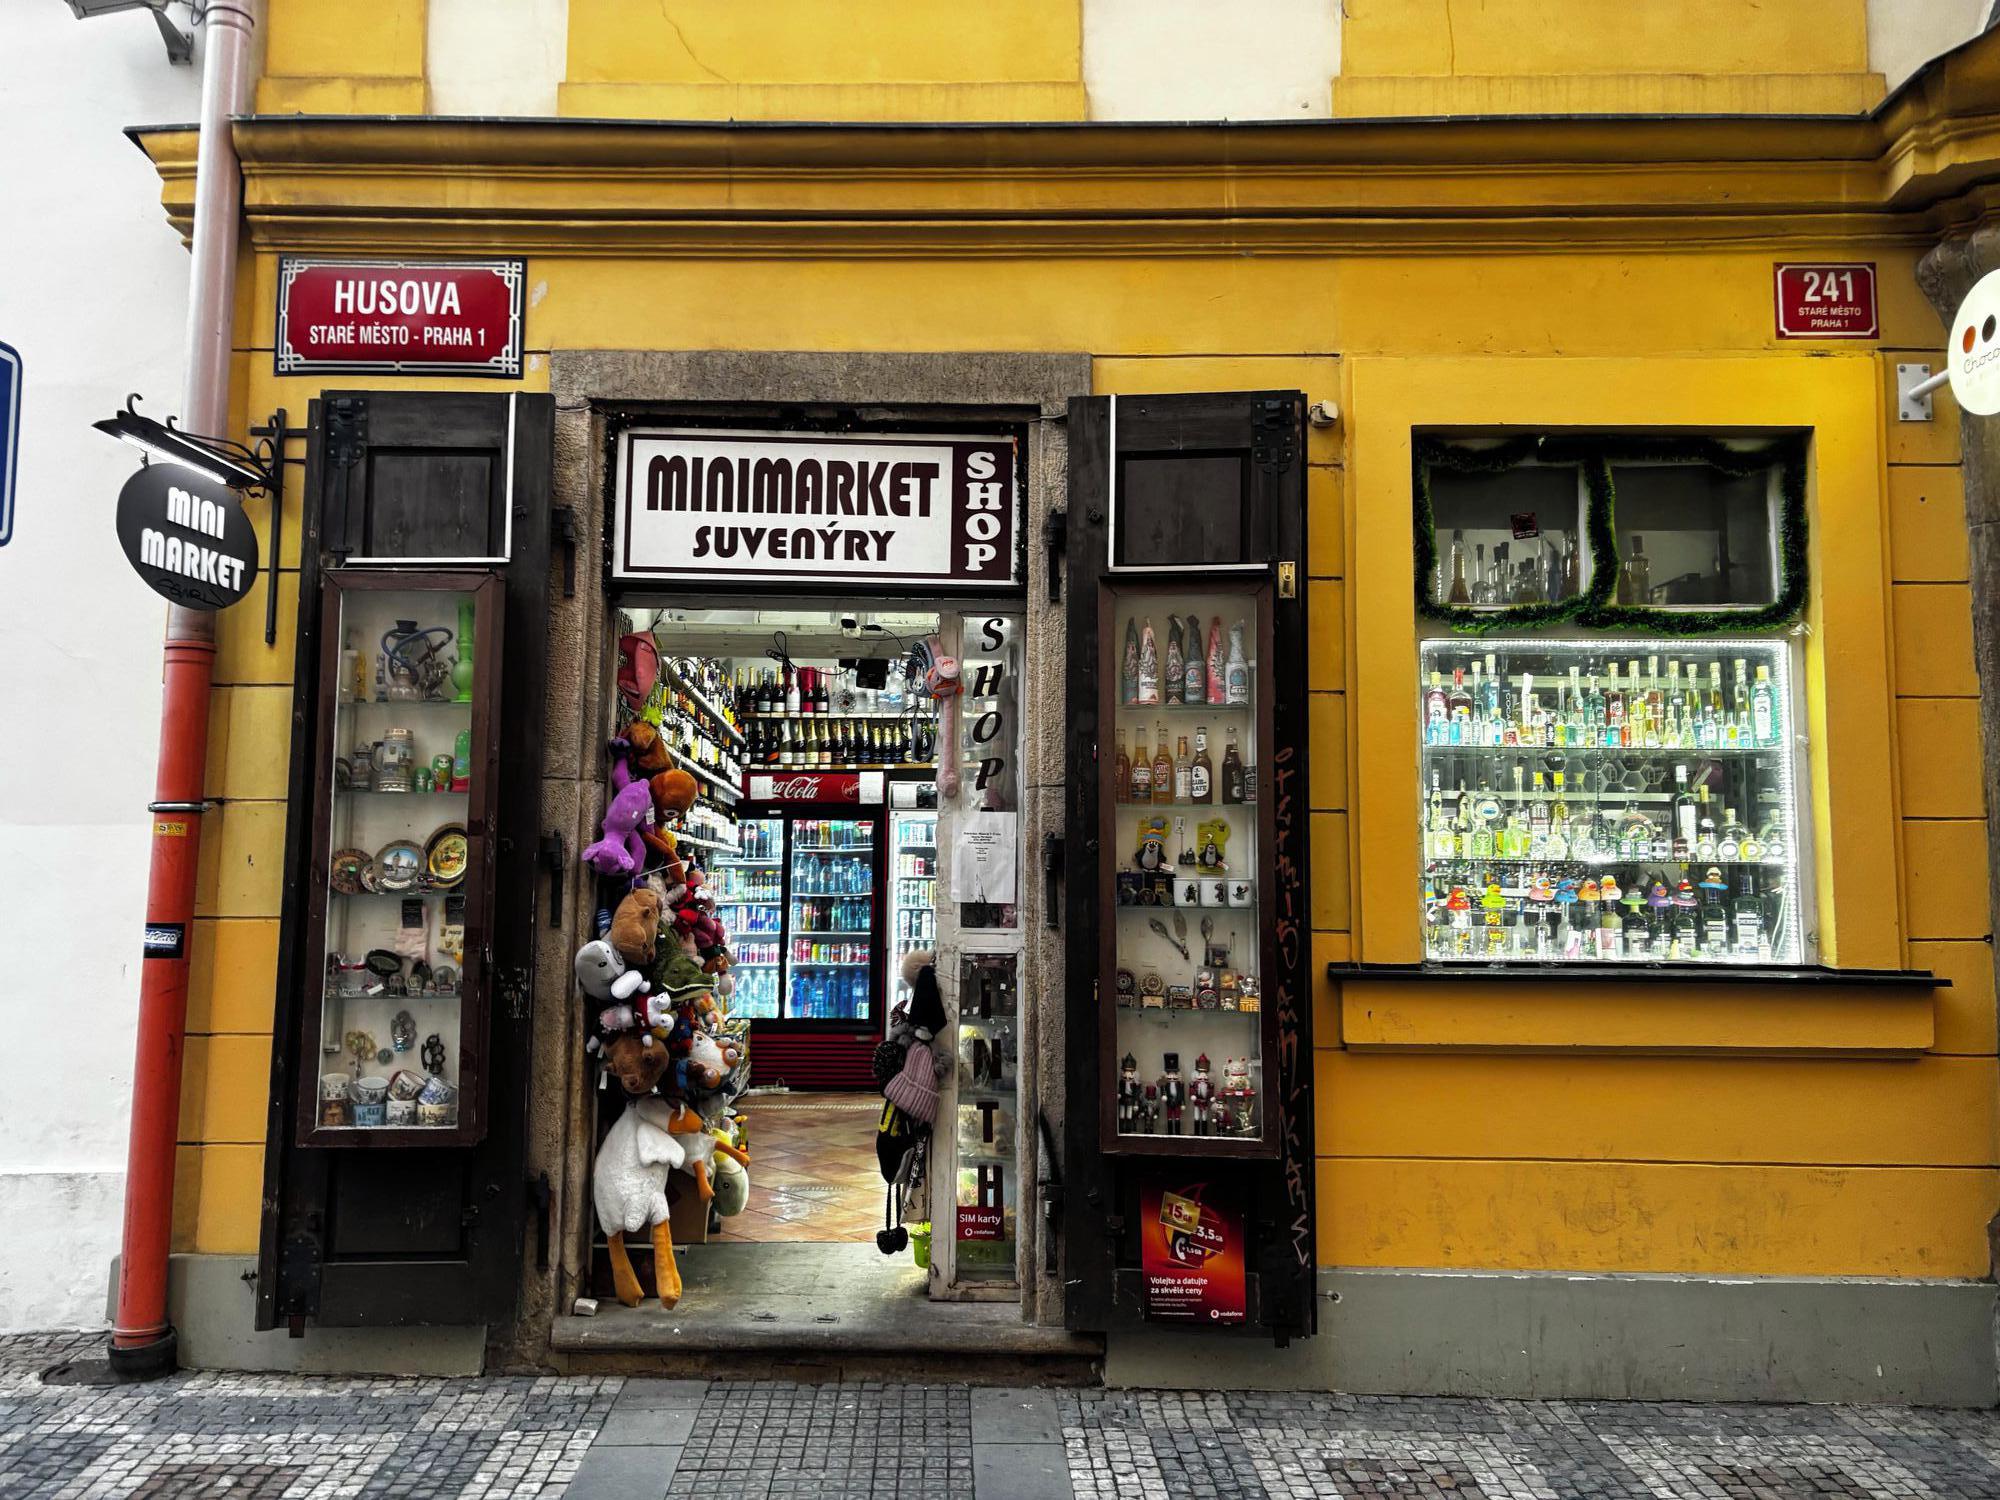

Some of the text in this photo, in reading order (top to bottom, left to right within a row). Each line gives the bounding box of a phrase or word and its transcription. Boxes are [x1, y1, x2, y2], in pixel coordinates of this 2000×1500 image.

[334, 279, 462, 316] HUSOVA
[1802, 271, 1854, 303] 241
[1798, 305, 1862, 316] STARÉ MĚSTO
[1810, 318, 1849, 328] PRAHA 1
[309, 320, 355, 345] STARÉ
[359, 321, 409, 345] MĚSTO
[423, 327, 473, 346] PRAHA
[477, 328, 485, 346] 1
[646, 454, 940, 518] MINIMARKET
[166, 486, 226, 540] MINI
[965, 451, 1003, 572] SHOP
[693, 521, 896, 562] SUVENÝRY
[140, 528, 245, 592] MARKET
[972, 617, 1004, 791] SHOP
[959, 1213, 1001, 1225] SIM karty
[1150, 1277, 1176, 1286] Volejte
[1182, 1277, 1208, 1286] datujte
[1160, 1286, 1184, 1294] skvělé
[1185, 1287, 1203, 1295] ceny
